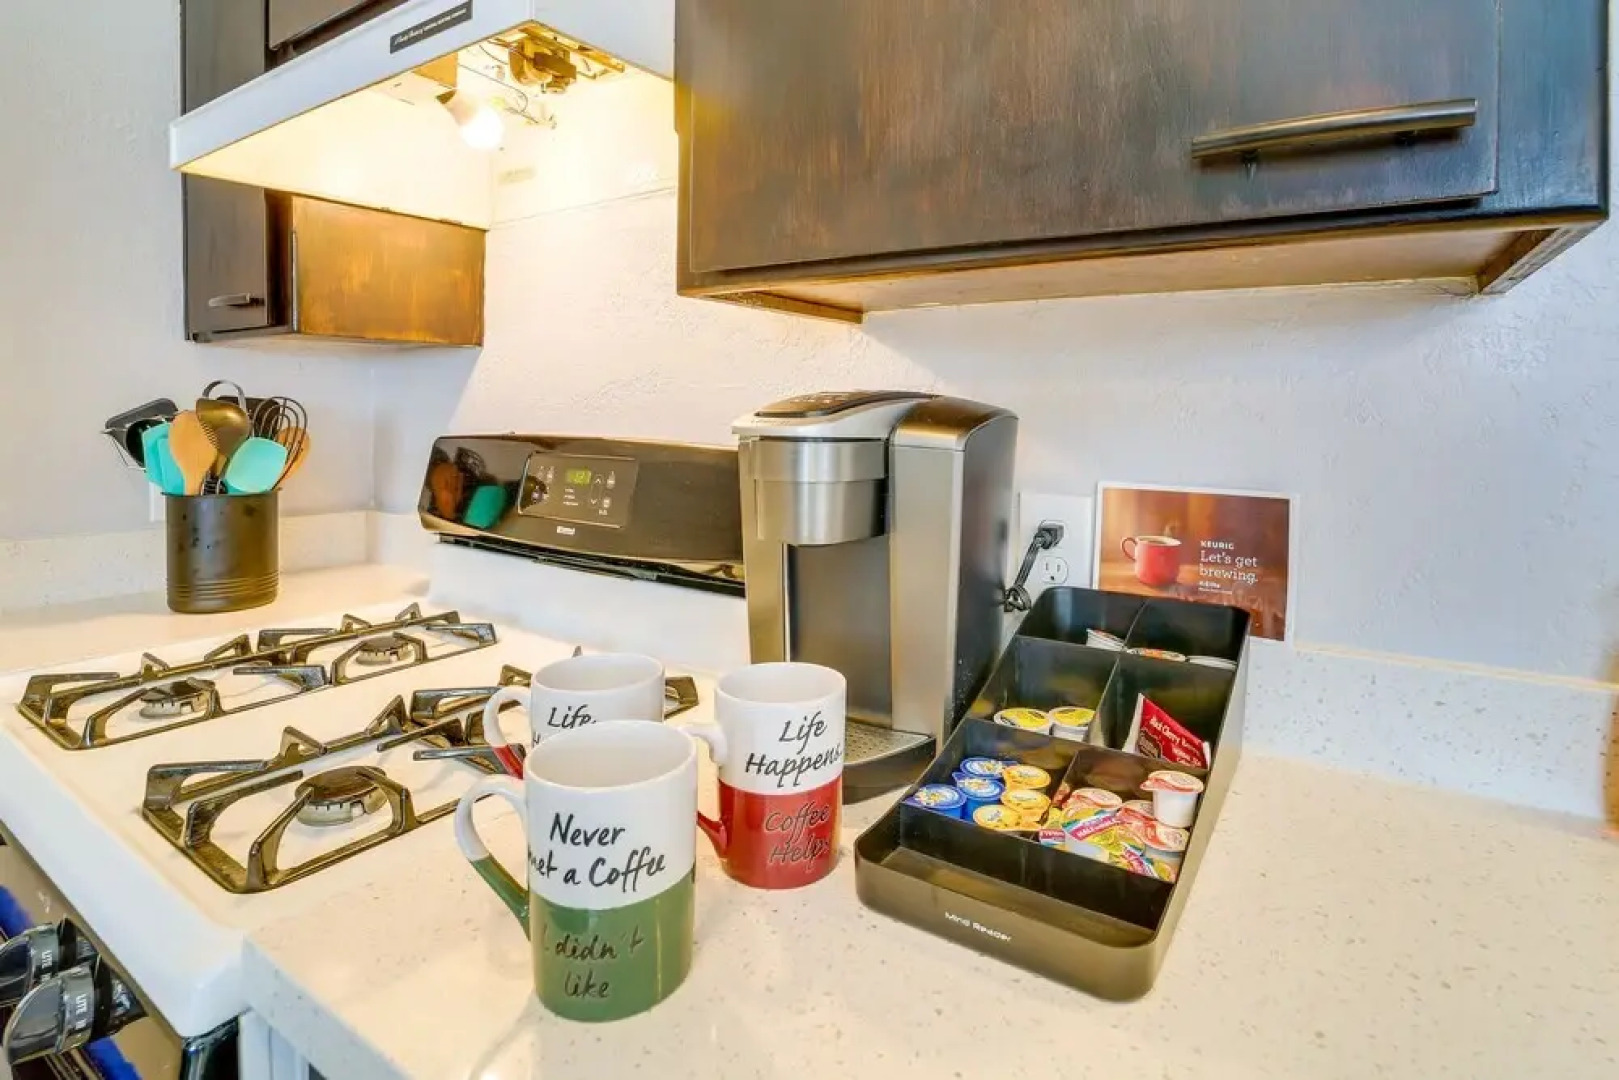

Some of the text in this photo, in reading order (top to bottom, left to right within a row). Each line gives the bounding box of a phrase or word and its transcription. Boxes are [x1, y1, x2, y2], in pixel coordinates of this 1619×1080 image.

[1200, 540, 1234, 550] KEURIG
[1200, 550, 1257, 568] Let's get
[1199, 563, 1258, 584] brewing.
[547, 704, 596, 729] Life
[779, 711, 828, 755] Life
[550, 812, 626, 847] Never
[765, 801, 829, 845] Coffee
[563, 867, 581, 885] a
[589, 847, 665, 893] Coffee
[973, 922, 1012, 942] Reader
[564, 968, 609, 999] like
